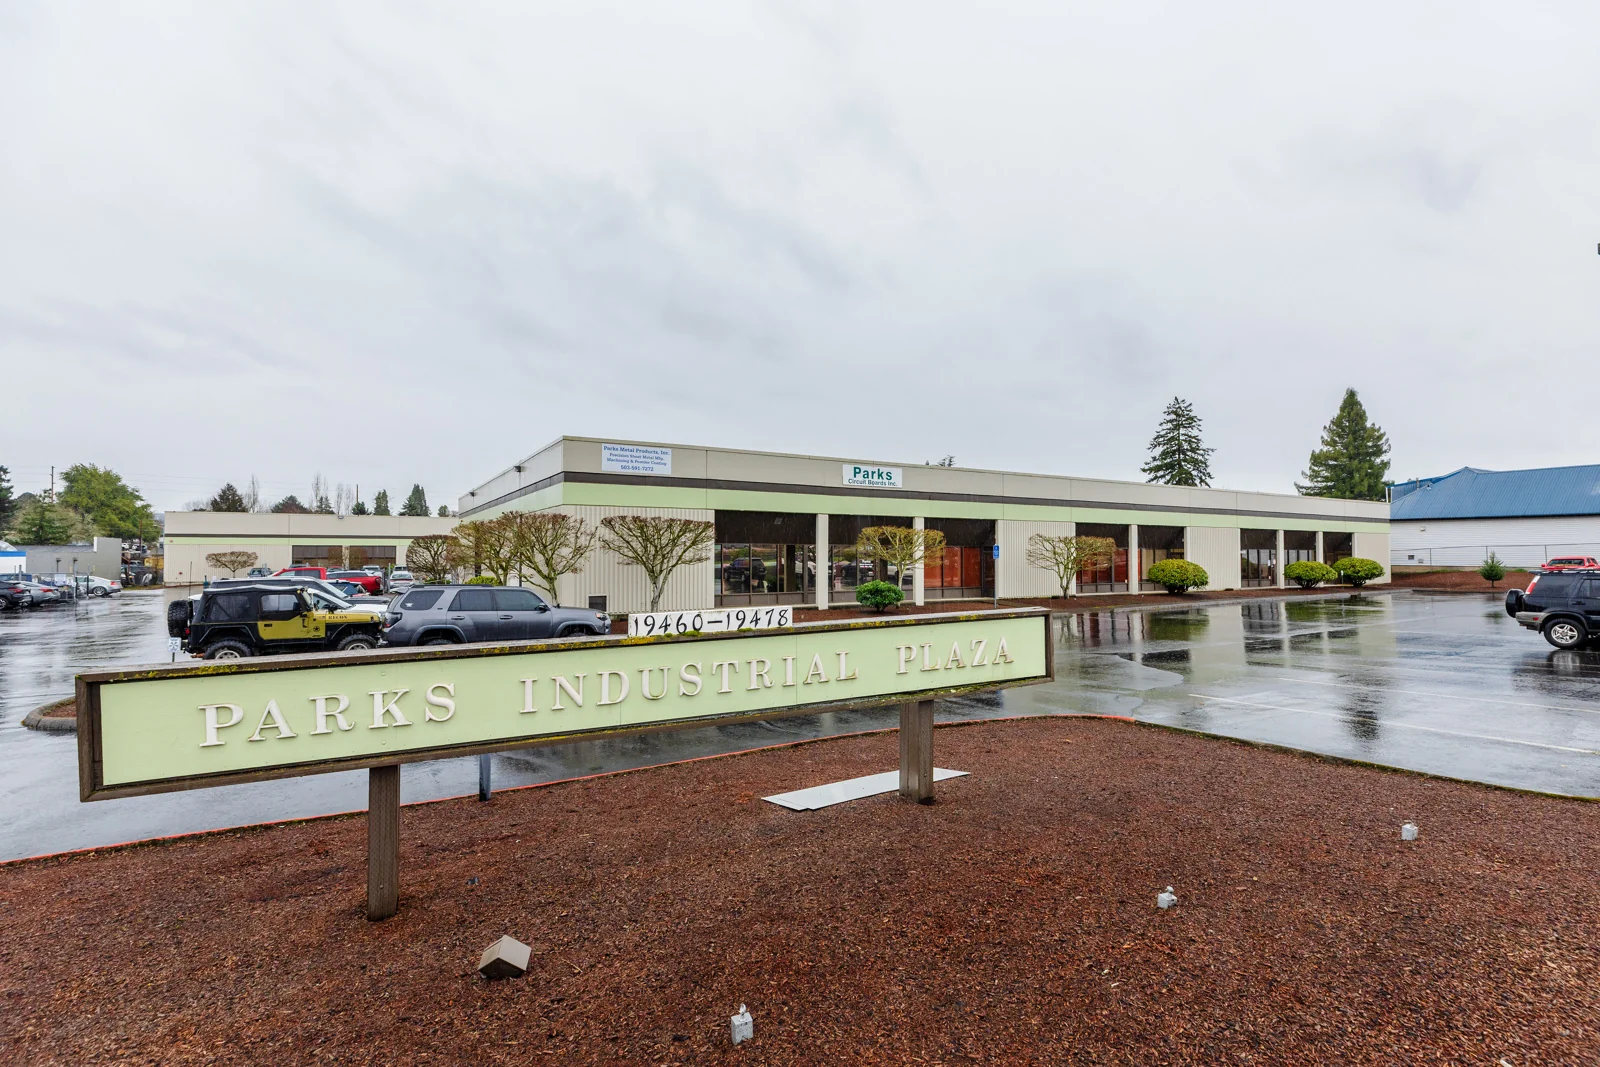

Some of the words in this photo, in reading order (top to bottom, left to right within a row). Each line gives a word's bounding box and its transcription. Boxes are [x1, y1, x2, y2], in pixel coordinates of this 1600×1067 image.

[853, 466, 893, 481] Parks
[198, 682, 456, 748] PARKS
[519, 650, 859, 715] INDUSTRIAL
[896, 636, 1014, 675] PLAZA
